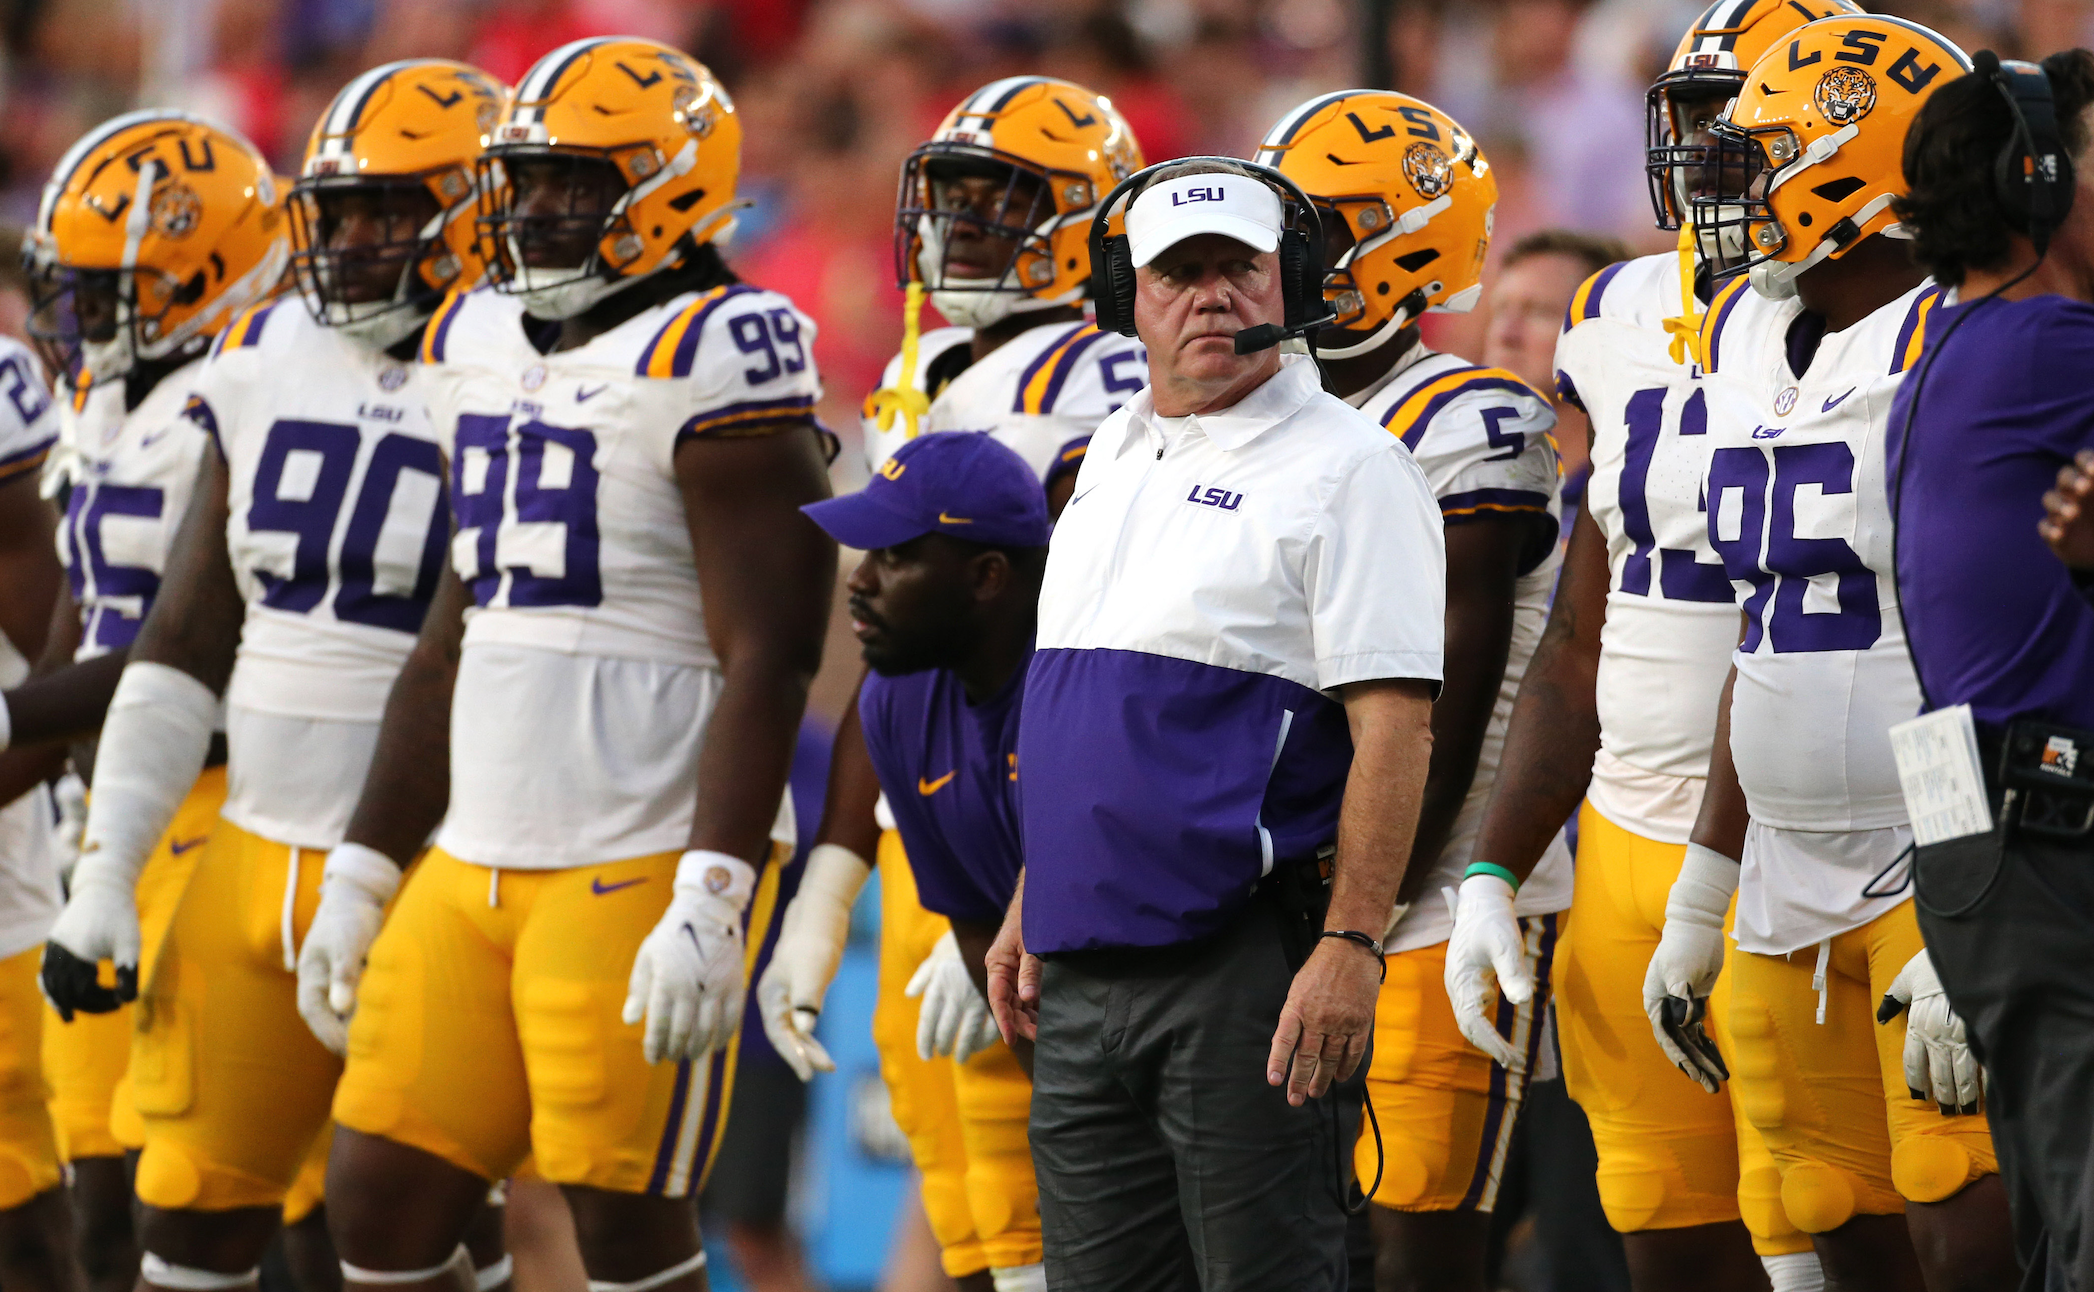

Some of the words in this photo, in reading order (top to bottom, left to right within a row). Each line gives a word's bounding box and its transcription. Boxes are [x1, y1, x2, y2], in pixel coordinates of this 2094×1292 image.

[1685, 54, 1720, 69] LSU
[1789, 30, 1942, 95] LSU
[1172, 187, 1224, 206] LSU
[728, 308, 806, 386] 99
[357, 402, 406, 424] LSU
[1099, 350, 1147, 415] 5
[1479, 406, 1525, 462] 5
[247, 419, 450, 635] 90
[451, 411, 603, 608] 99
[1187, 485, 1243, 510] LSU
[1706, 441, 1882, 654] 96
